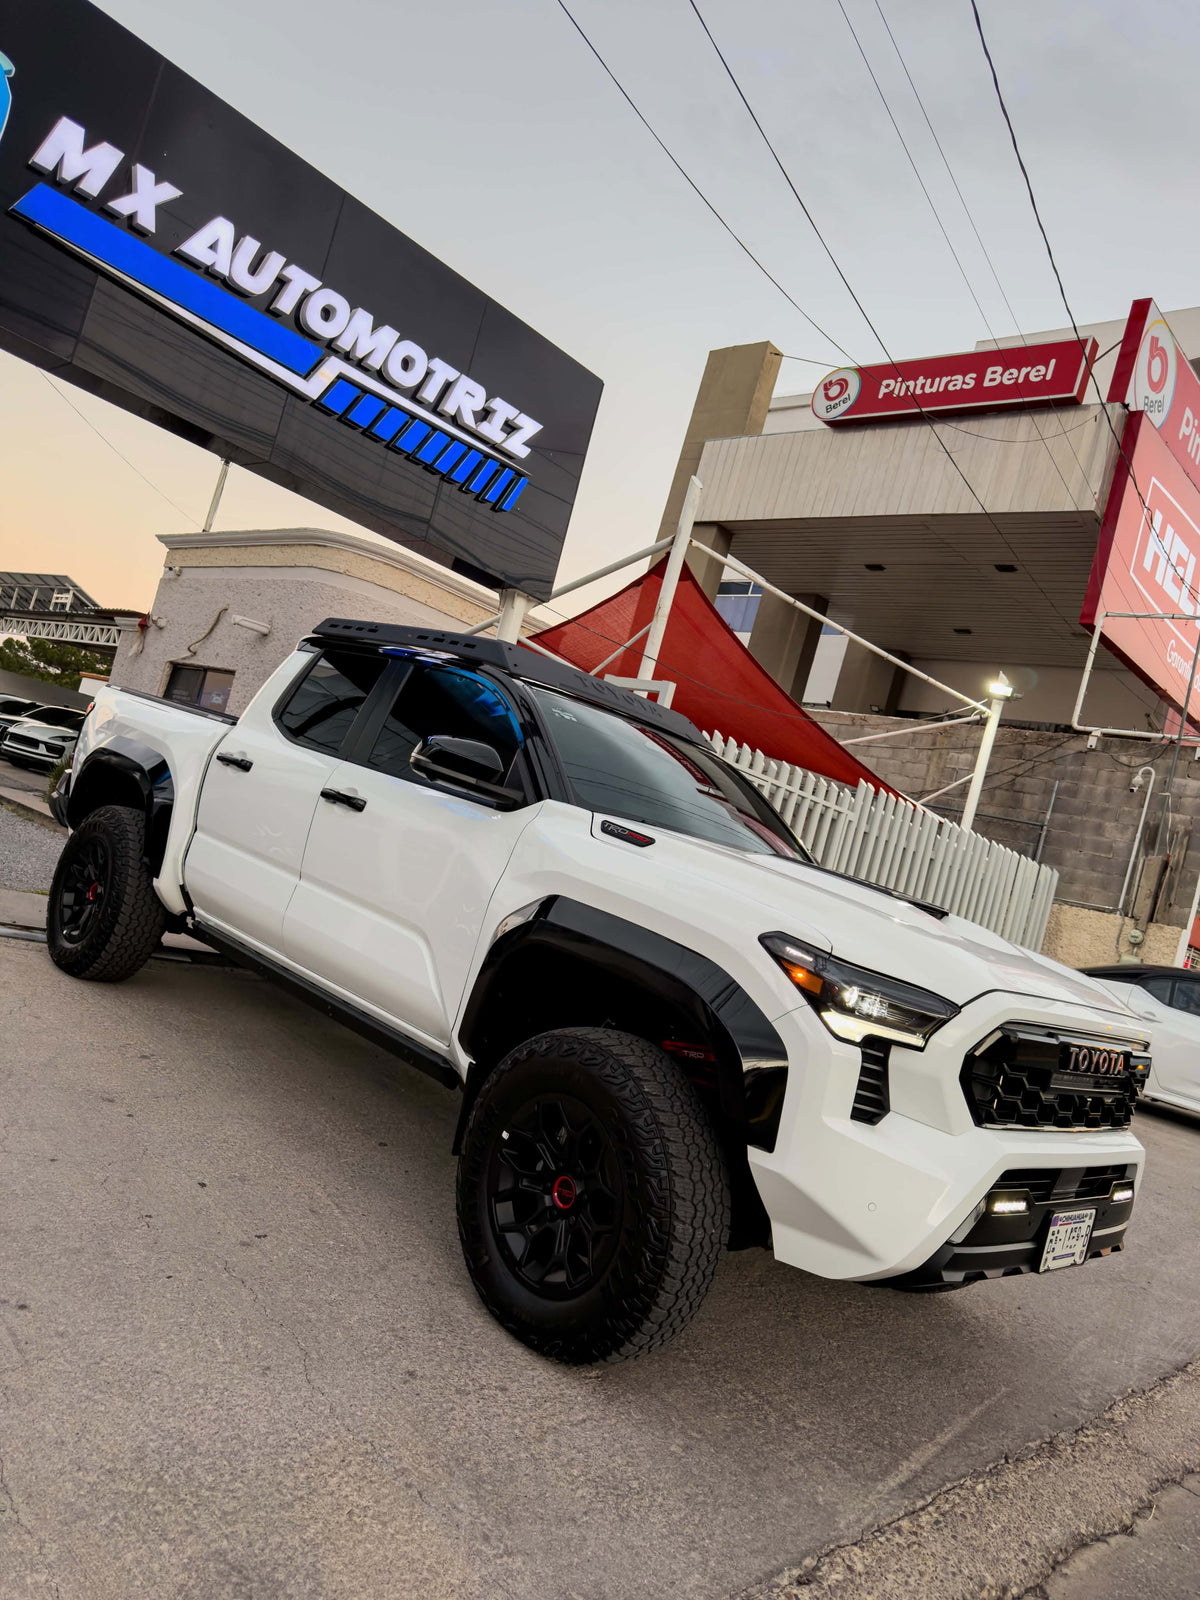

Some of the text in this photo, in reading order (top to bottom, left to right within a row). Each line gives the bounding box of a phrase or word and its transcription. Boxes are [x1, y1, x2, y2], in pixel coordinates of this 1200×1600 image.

[175, 216, 543, 457] AUTOMOTRIZ
[878, 359, 1056, 399] Pinturas Berel
[825, 393, 851, 414] Berel
[1143, 394, 1165, 413] Berel
[604, 821, 628, 835] TRD
[682, 1049, 705, 1059] TRD
[1069, 1047, 1124, 1075] TOYOTA
